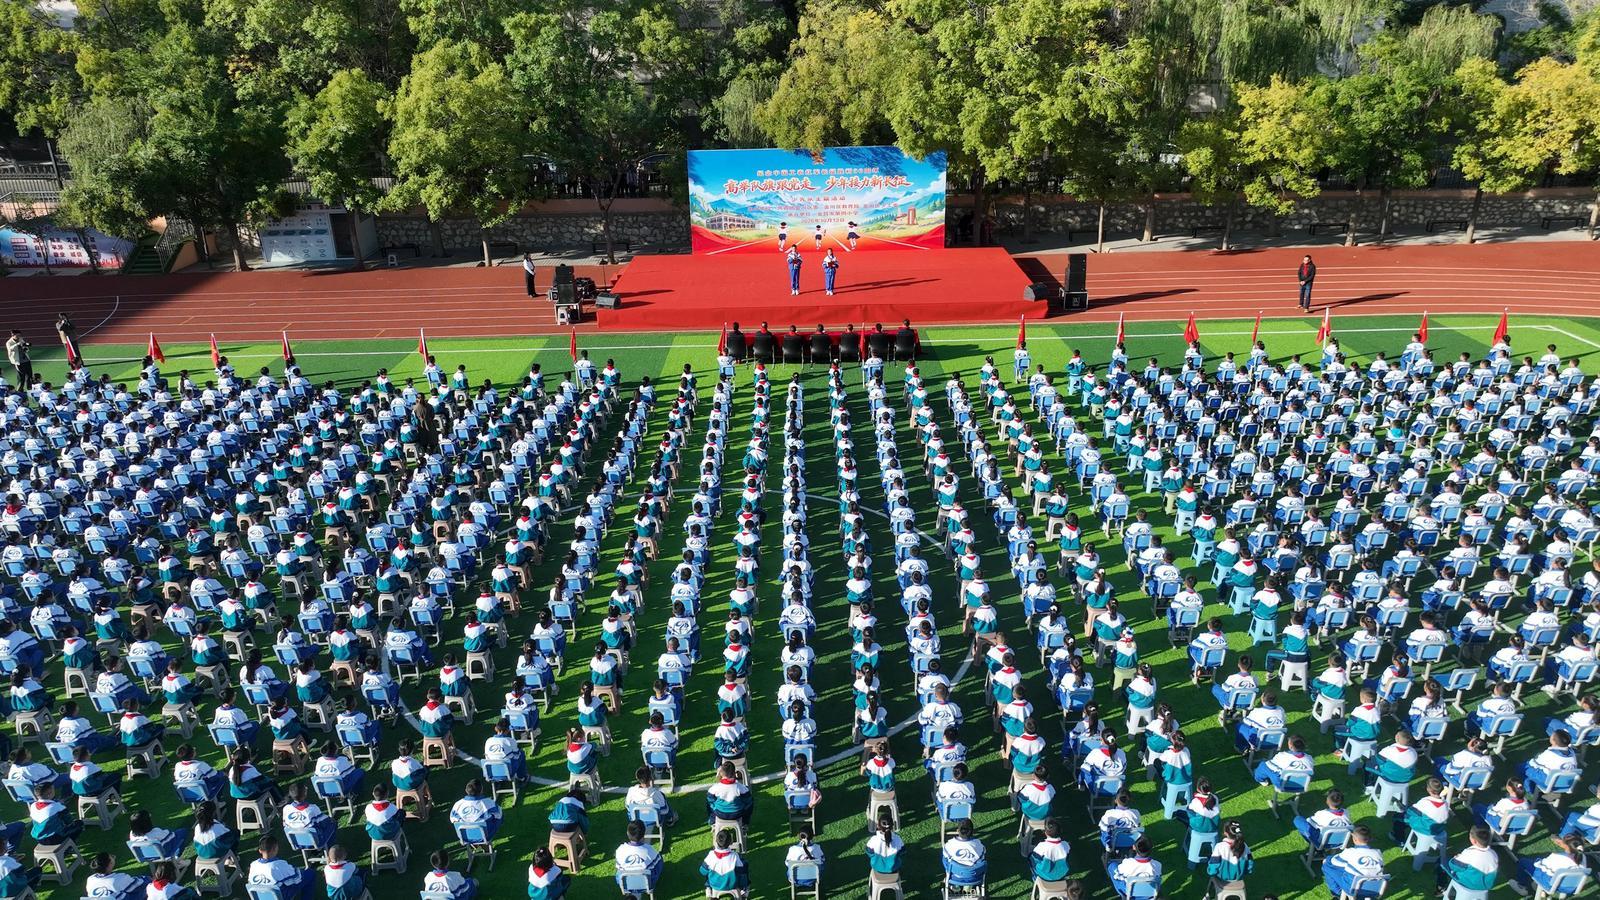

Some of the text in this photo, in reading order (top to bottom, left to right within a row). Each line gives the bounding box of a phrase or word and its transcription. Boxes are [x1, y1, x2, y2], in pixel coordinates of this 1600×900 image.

[724, 175, 912, 195] 高举队旗跟党走 少年接力新长征
